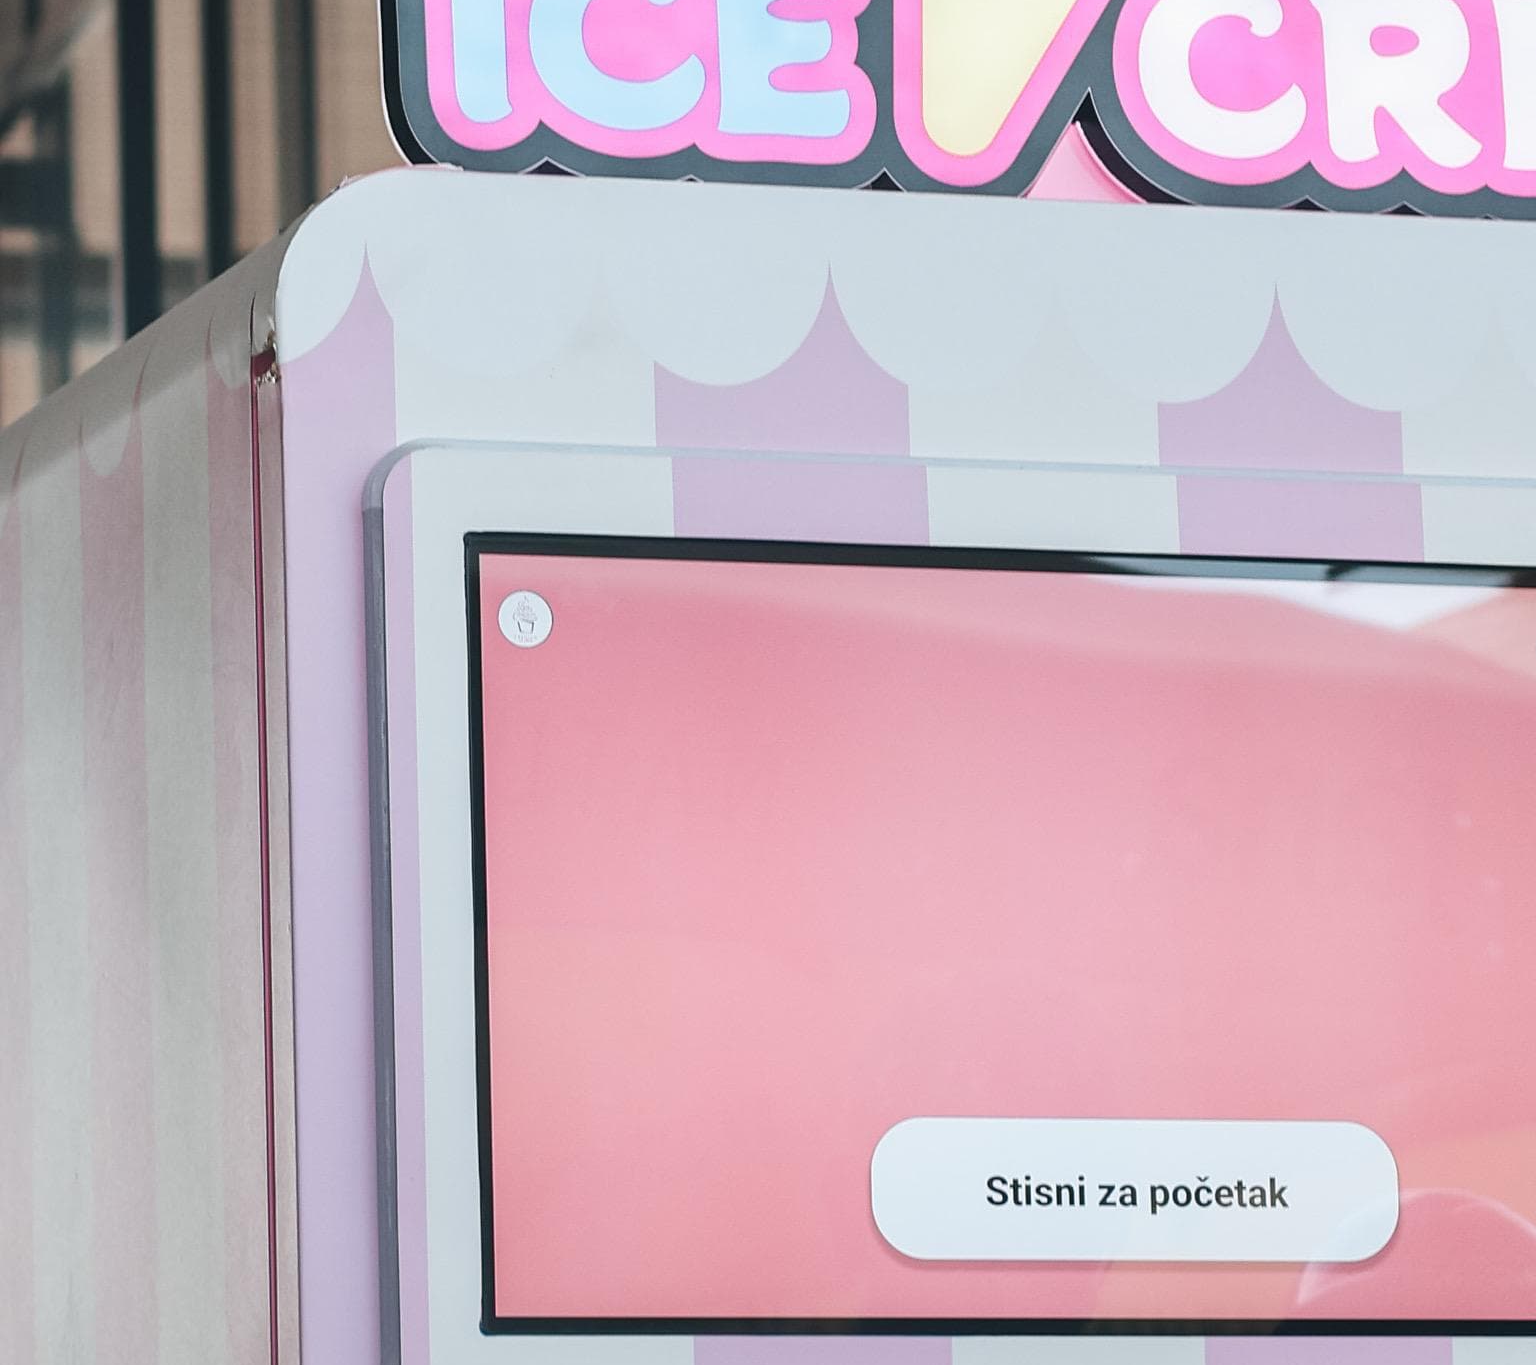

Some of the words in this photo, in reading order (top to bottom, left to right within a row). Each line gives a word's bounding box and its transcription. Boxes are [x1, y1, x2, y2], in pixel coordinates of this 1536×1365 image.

[985, 1175, 1086, 1207] Stisni
[1098, 1182, 1138, 1208] za
[1150, 1175, 1290, 1216] početak
